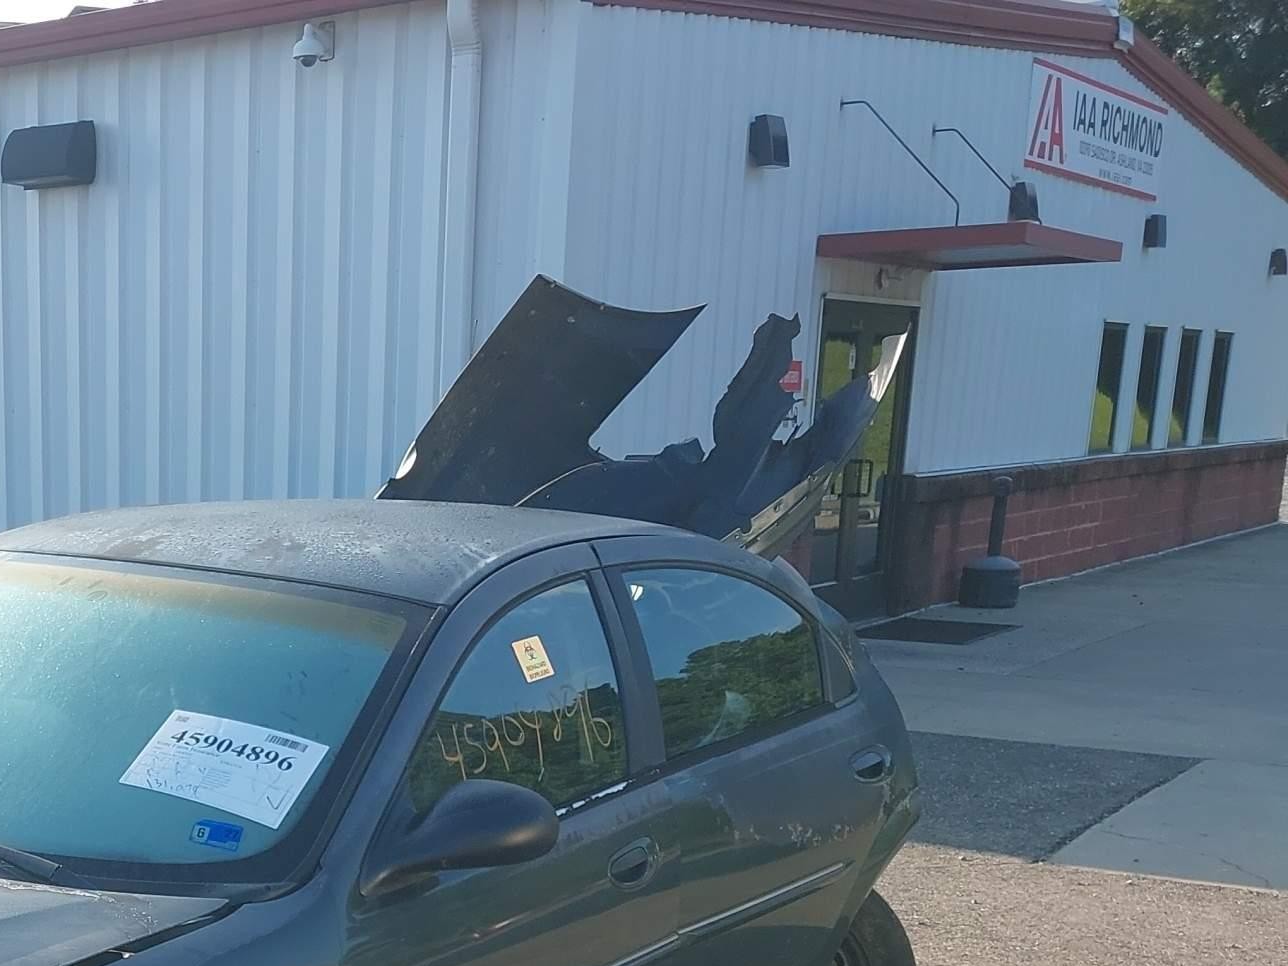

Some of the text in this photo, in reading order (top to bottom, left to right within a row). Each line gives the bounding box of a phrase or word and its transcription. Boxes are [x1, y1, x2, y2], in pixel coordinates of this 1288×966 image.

[1073, 91, 1163, 157] IAA RICHMOND
[171, 729, 298, 772] 45904896
[436, 679, 611, 781] 45904896
[196, 827, 206, 838] 6
